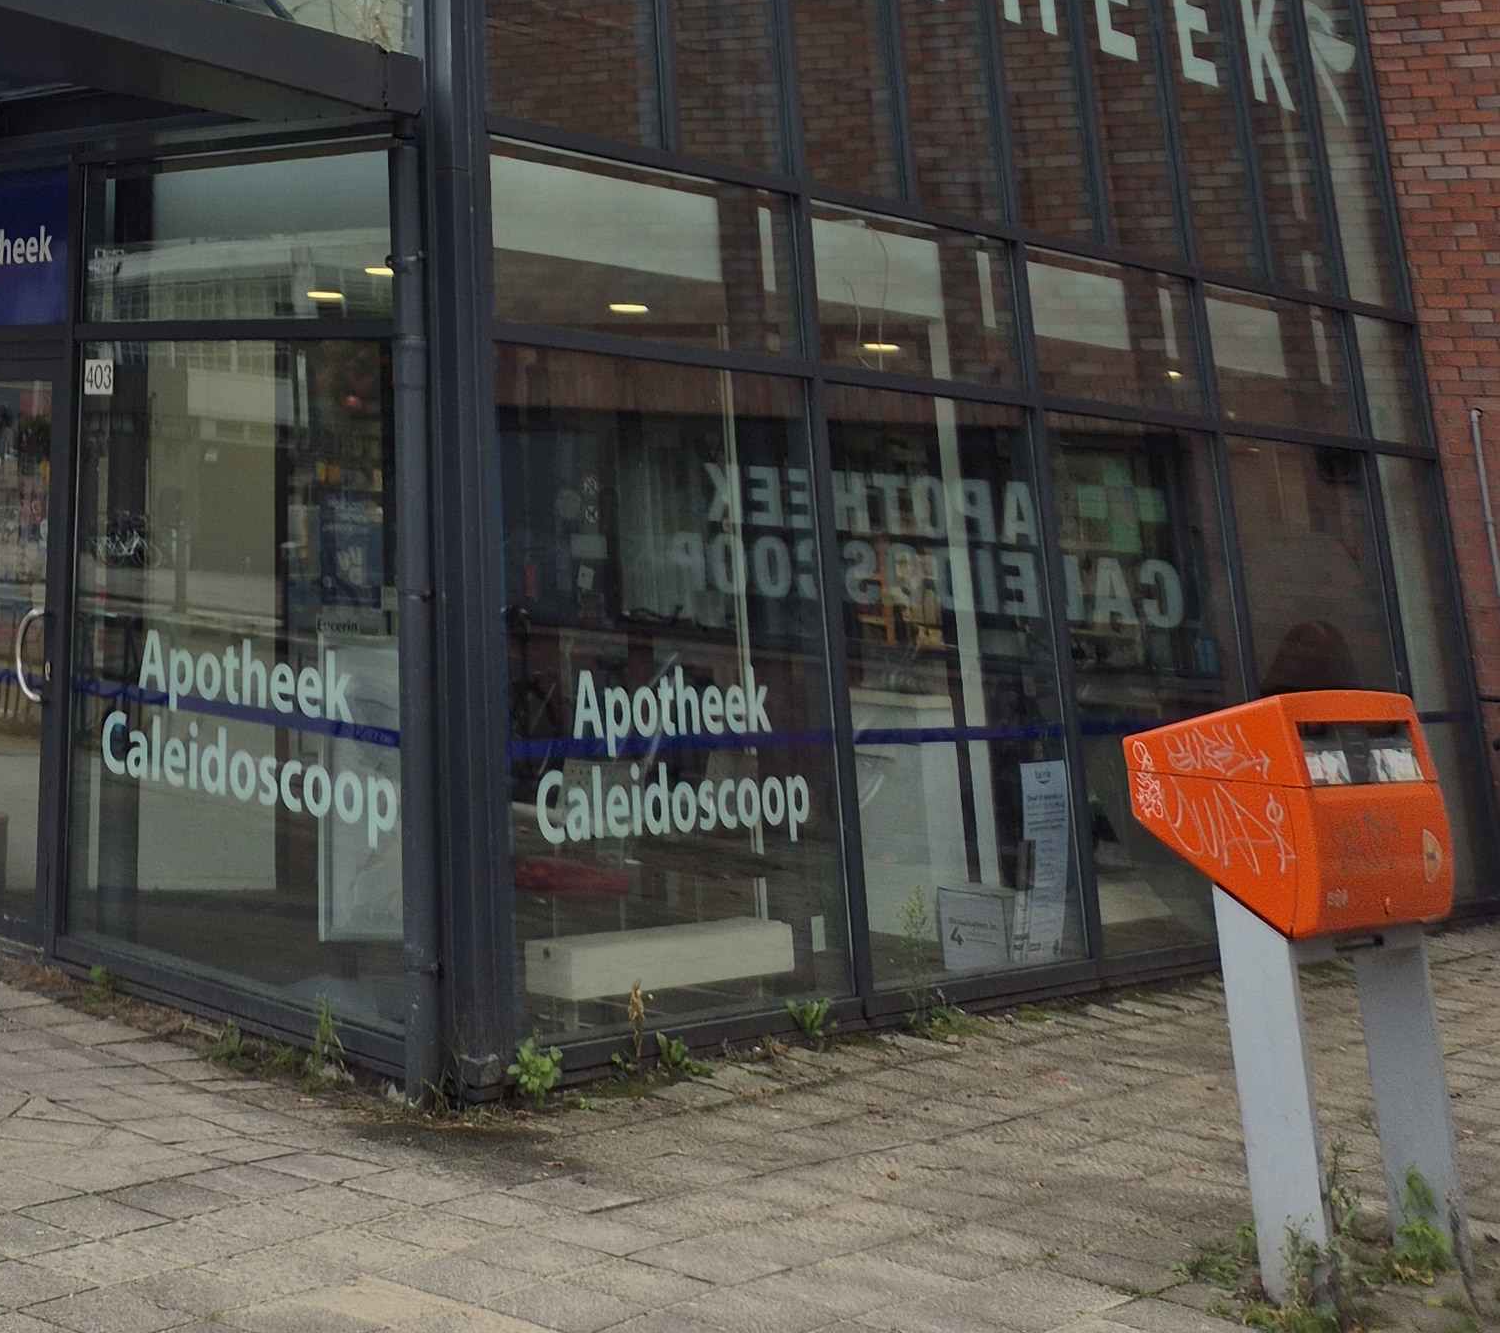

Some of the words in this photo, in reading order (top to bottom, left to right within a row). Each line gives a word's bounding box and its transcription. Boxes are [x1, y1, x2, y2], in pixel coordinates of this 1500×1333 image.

[86, 364, 112, 390] 403
[138, 630, 352, 721] Apotheek
[573, 664, 772, 758] Apotheek
[101, 711, 398, 847] Caleidoscoop
[535, 764, 810, 844] Caleidoscoop
